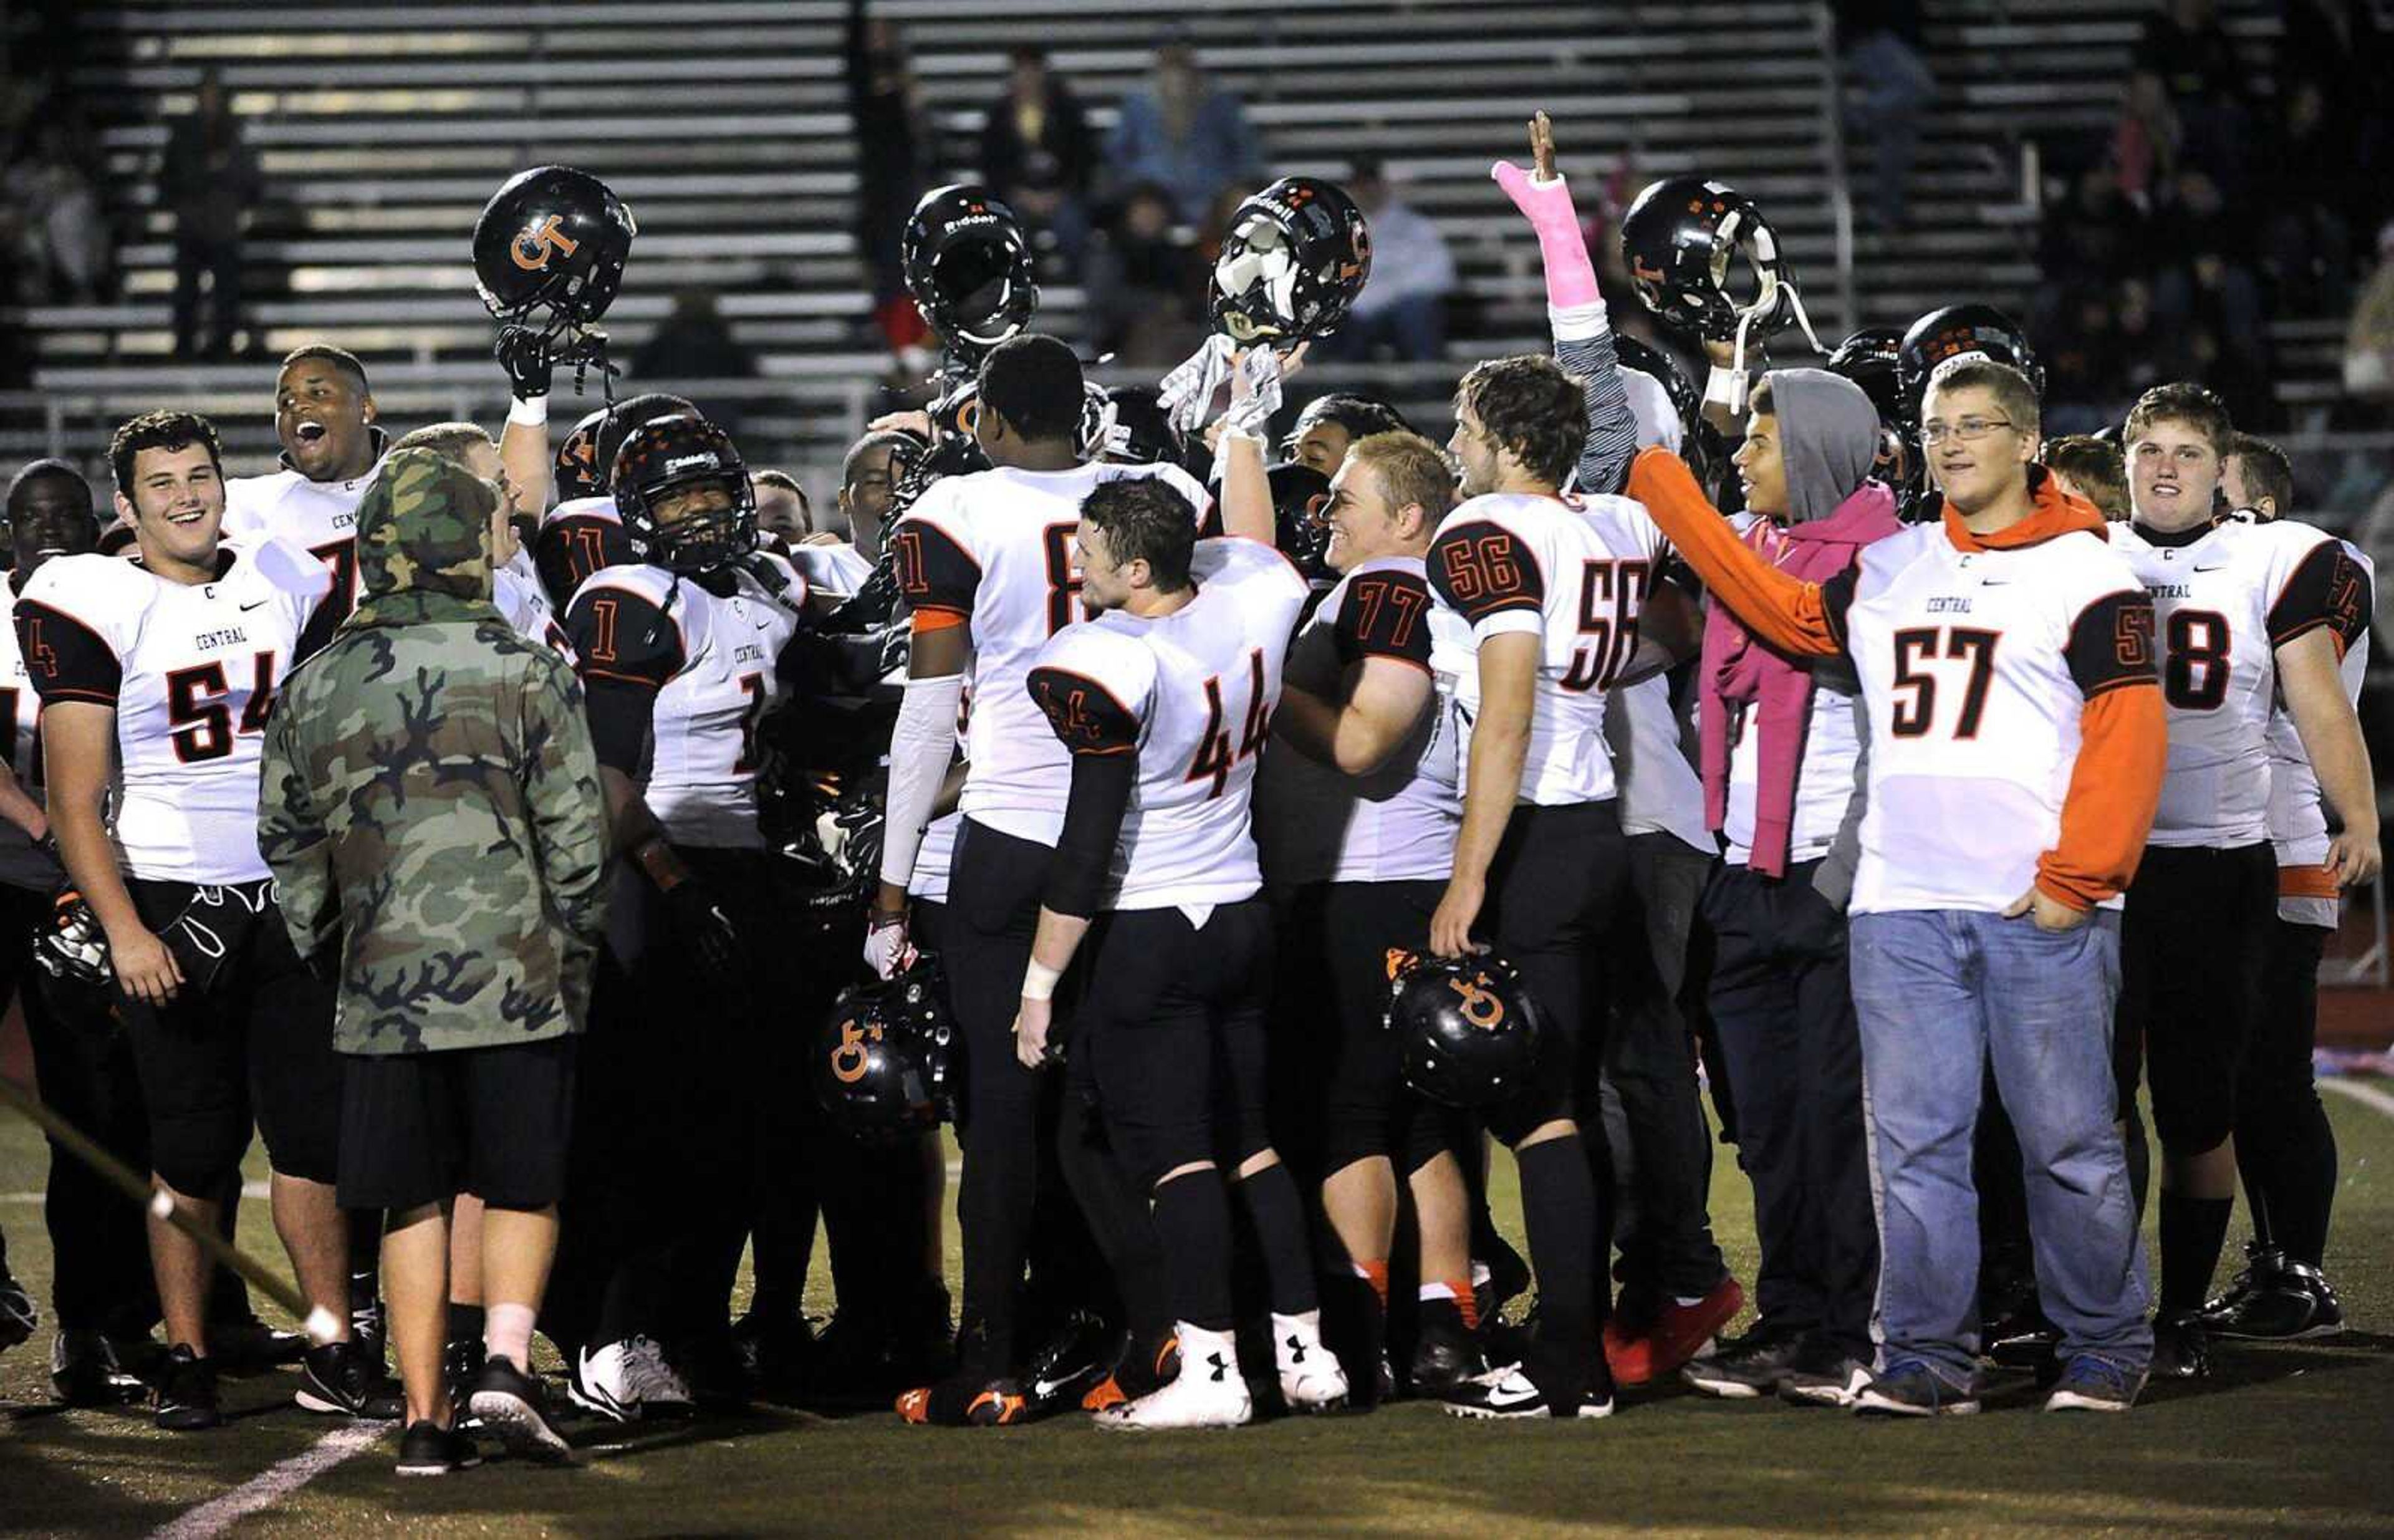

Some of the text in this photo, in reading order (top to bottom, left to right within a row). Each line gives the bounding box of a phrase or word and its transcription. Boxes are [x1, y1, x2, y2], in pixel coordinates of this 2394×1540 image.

[1244, 195, 1296, 222] iddell
[204, 586, 215, 599] C
[1441, 535, 1521, 601] 56
[2145, 584, 2191, 599] NTRAL
[195, 626, 248, 650] CENTRAL
[592, 599, 617, 662] 1
[1358, 581, 1427, 647] 77
[1892, 625, 2004, 741] 57
[1185, 646, 1270, 801] 44
